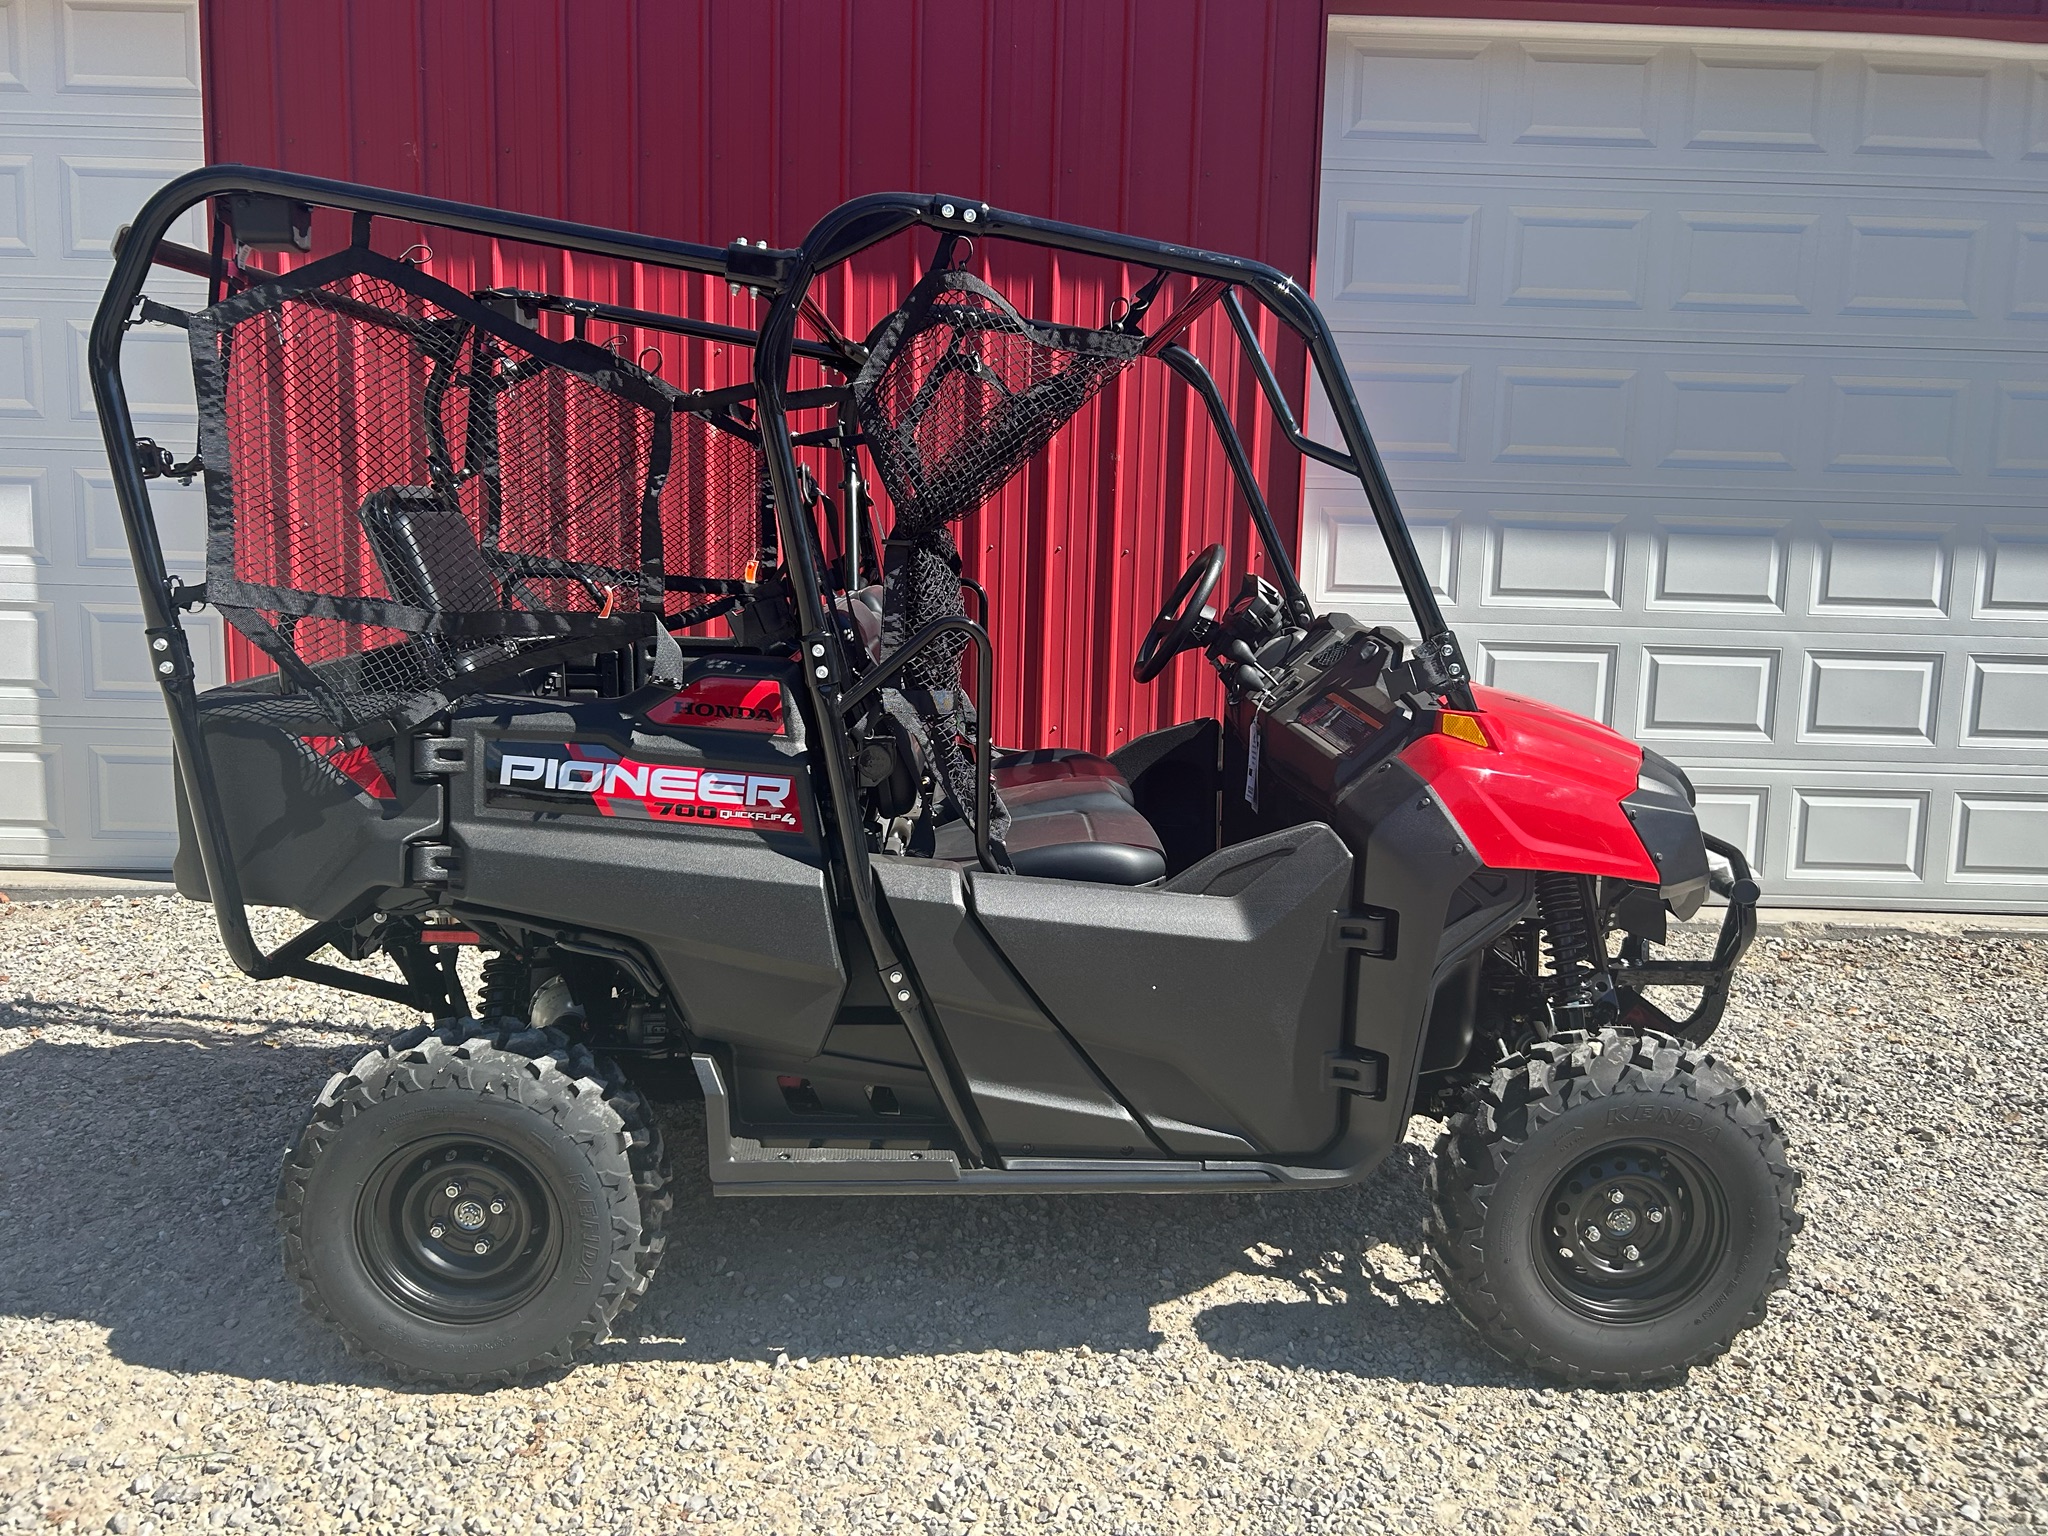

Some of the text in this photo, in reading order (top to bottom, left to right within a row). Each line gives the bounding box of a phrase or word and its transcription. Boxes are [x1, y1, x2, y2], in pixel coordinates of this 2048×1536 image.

[674, 701, 776, 722] HONDA
[500, 755, 791, 808] PIONEER
[653, 801, 717, 819] 700
[1606, 1103, 1722, 1142] KENDA
